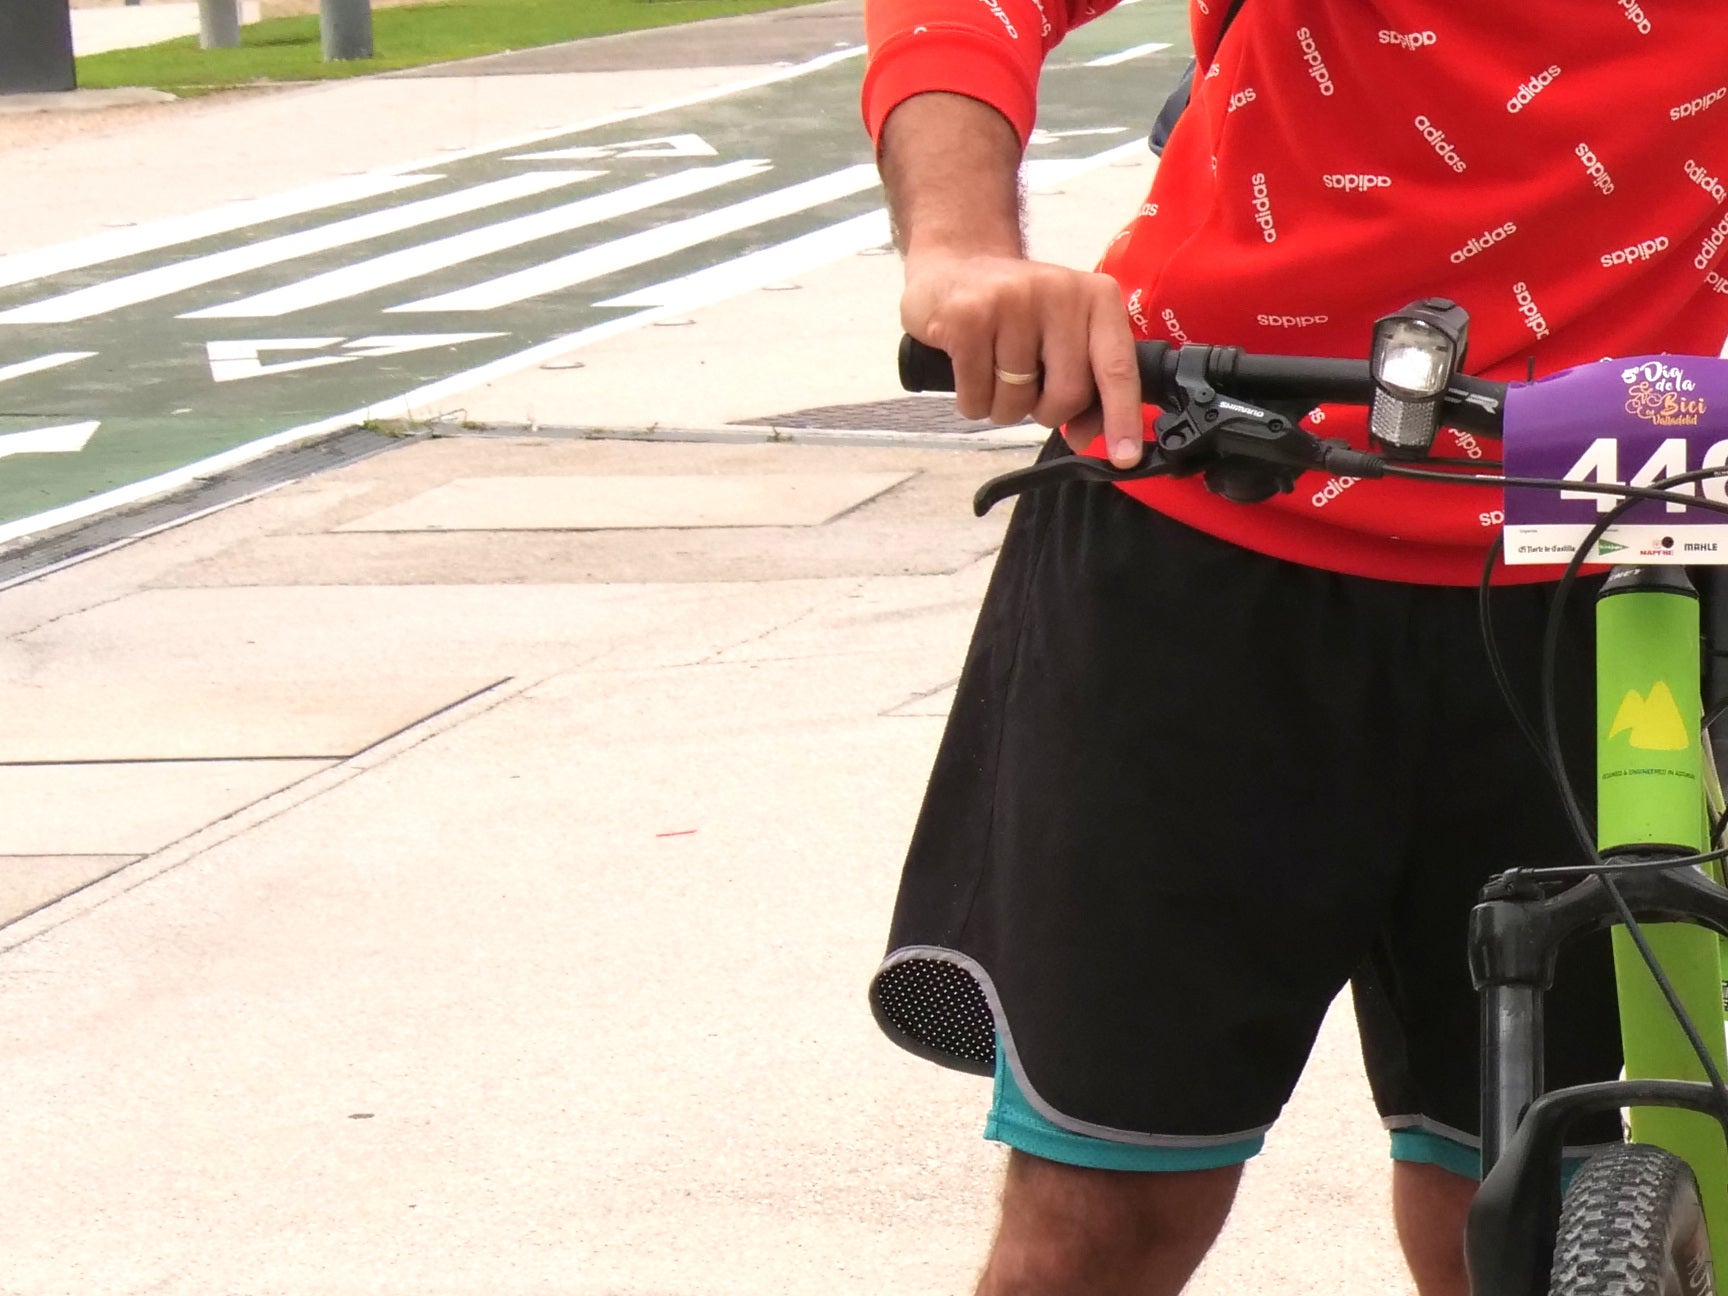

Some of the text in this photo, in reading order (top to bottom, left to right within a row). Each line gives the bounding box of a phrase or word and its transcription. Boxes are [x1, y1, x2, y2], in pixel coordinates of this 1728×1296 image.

[1297, 27, 1335, 97] adidas
[1506, 64, 1562, 114] adidas
[1670, 87, 1727, 121] adidas
[1414, 115, 1467, 173] adidas
[1323, 174, 1392, 192] adidas
[1575, 142, 1615, 195] adidas
[1252, 173, 1277, 243] adidas
[1450, 221, 1517, 264] adidas
[1600, 236, 1669, 268] adidas
[1257, 314, 1329, 328] adidas
[1219, 401, 1264, 418] SHIMANO
[1661, 393, 1707, 415] Bici
[1684, 543, 1719, 552] MAHLE
